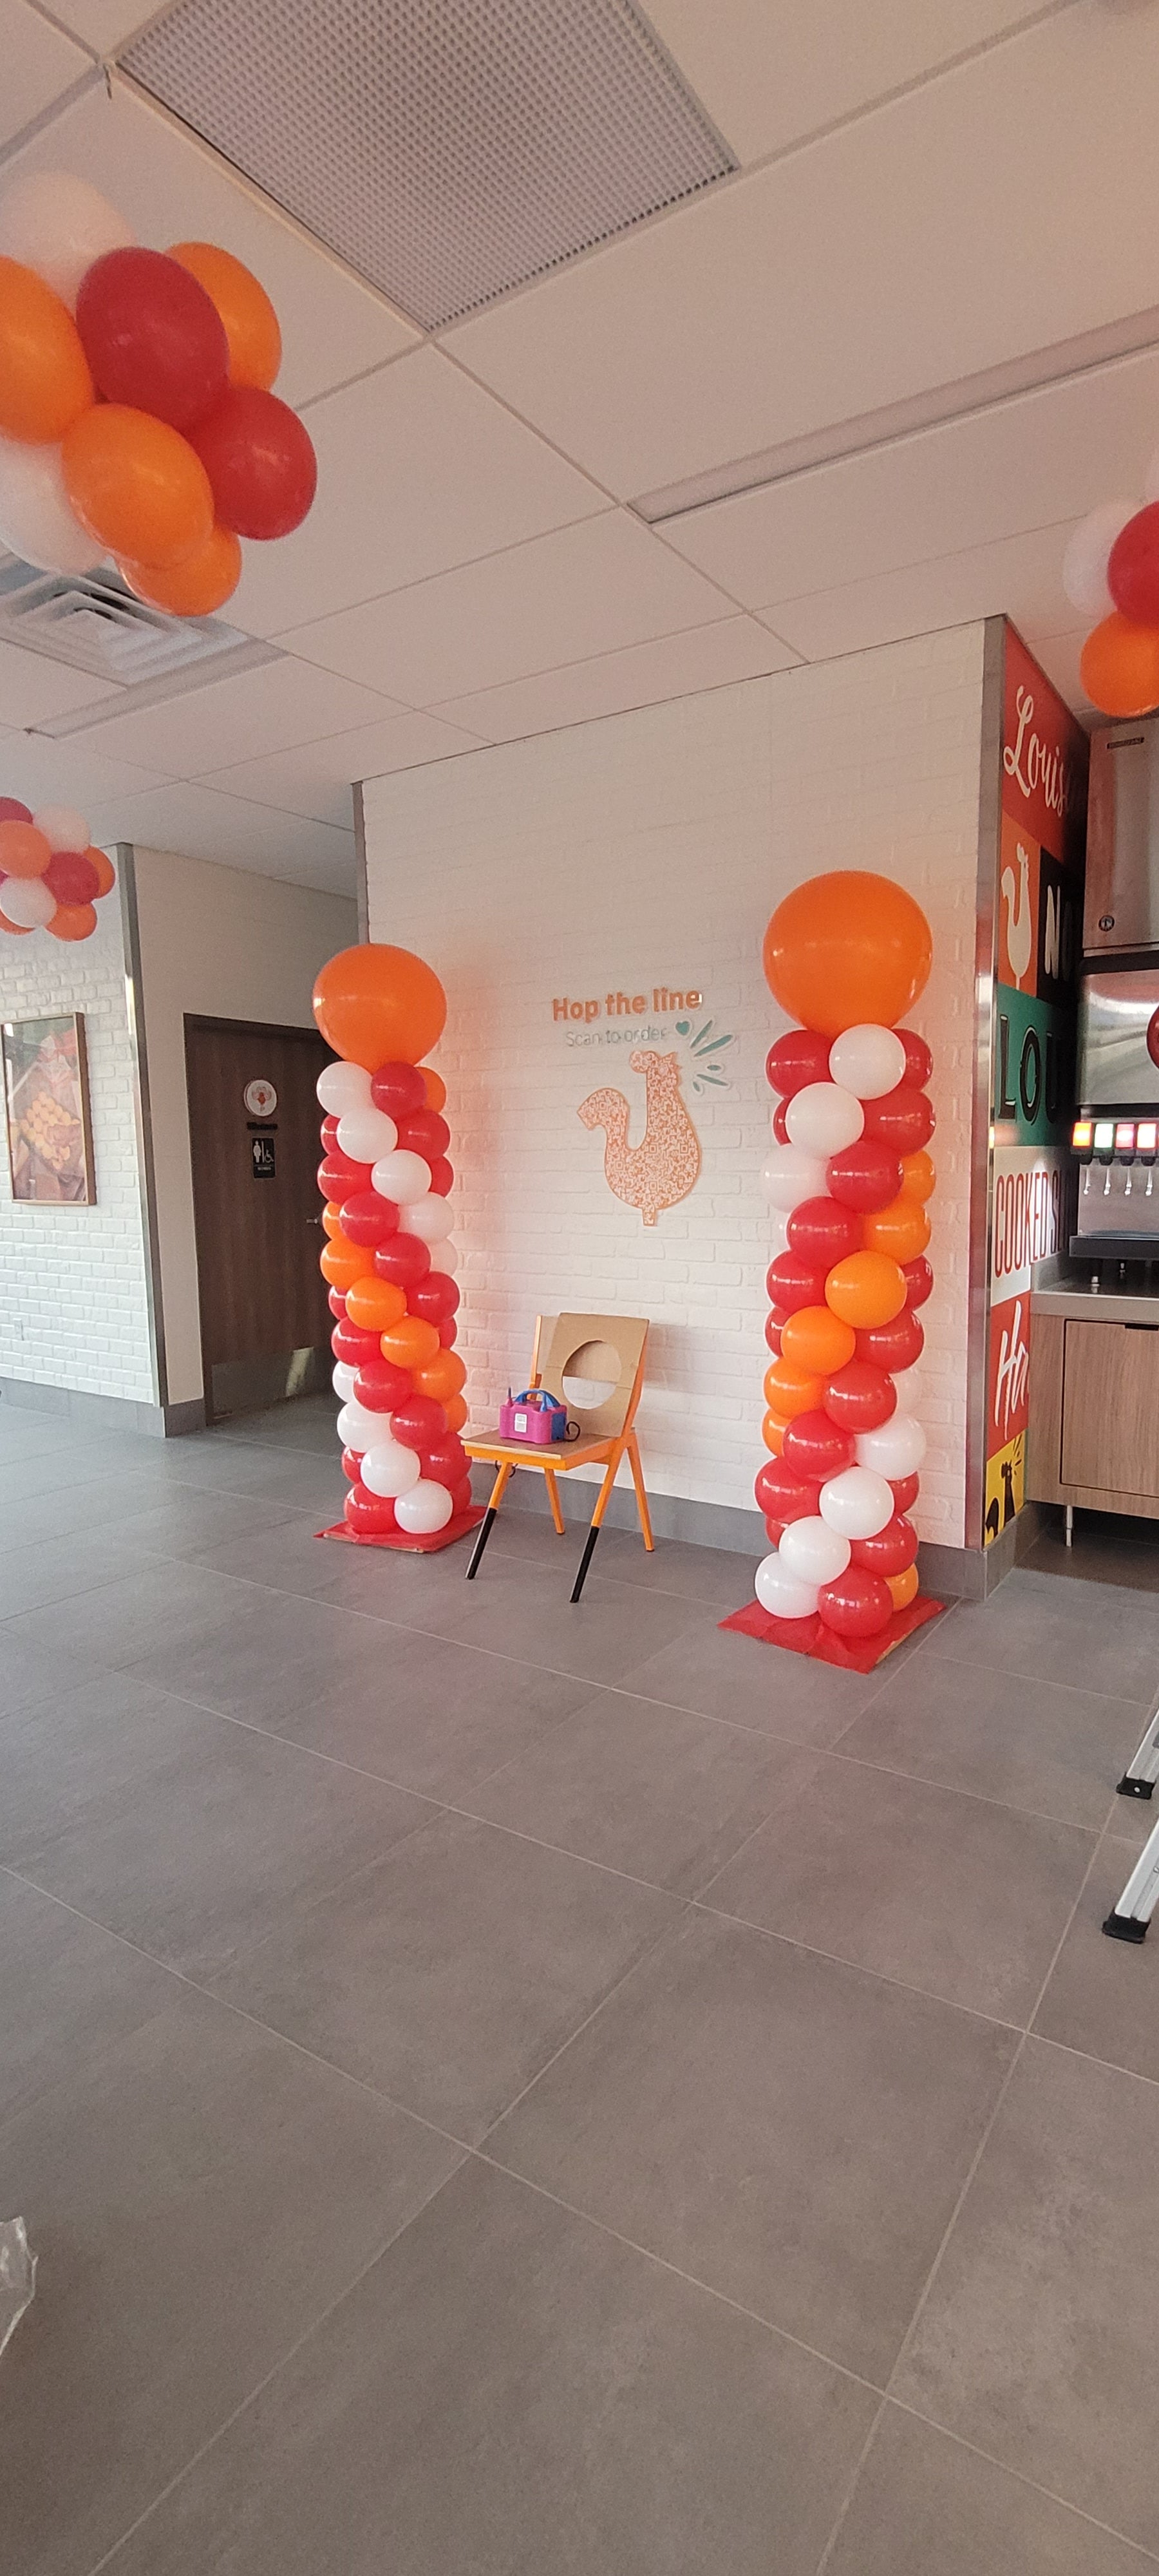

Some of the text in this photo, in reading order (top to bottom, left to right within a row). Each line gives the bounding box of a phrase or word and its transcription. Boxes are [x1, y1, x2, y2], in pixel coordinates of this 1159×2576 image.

[552, 987, 702, 1024] Hop the line
[566, 1025, 668, 1047] Scan to order
[995, 1171, 1048, 1278] COOKED
